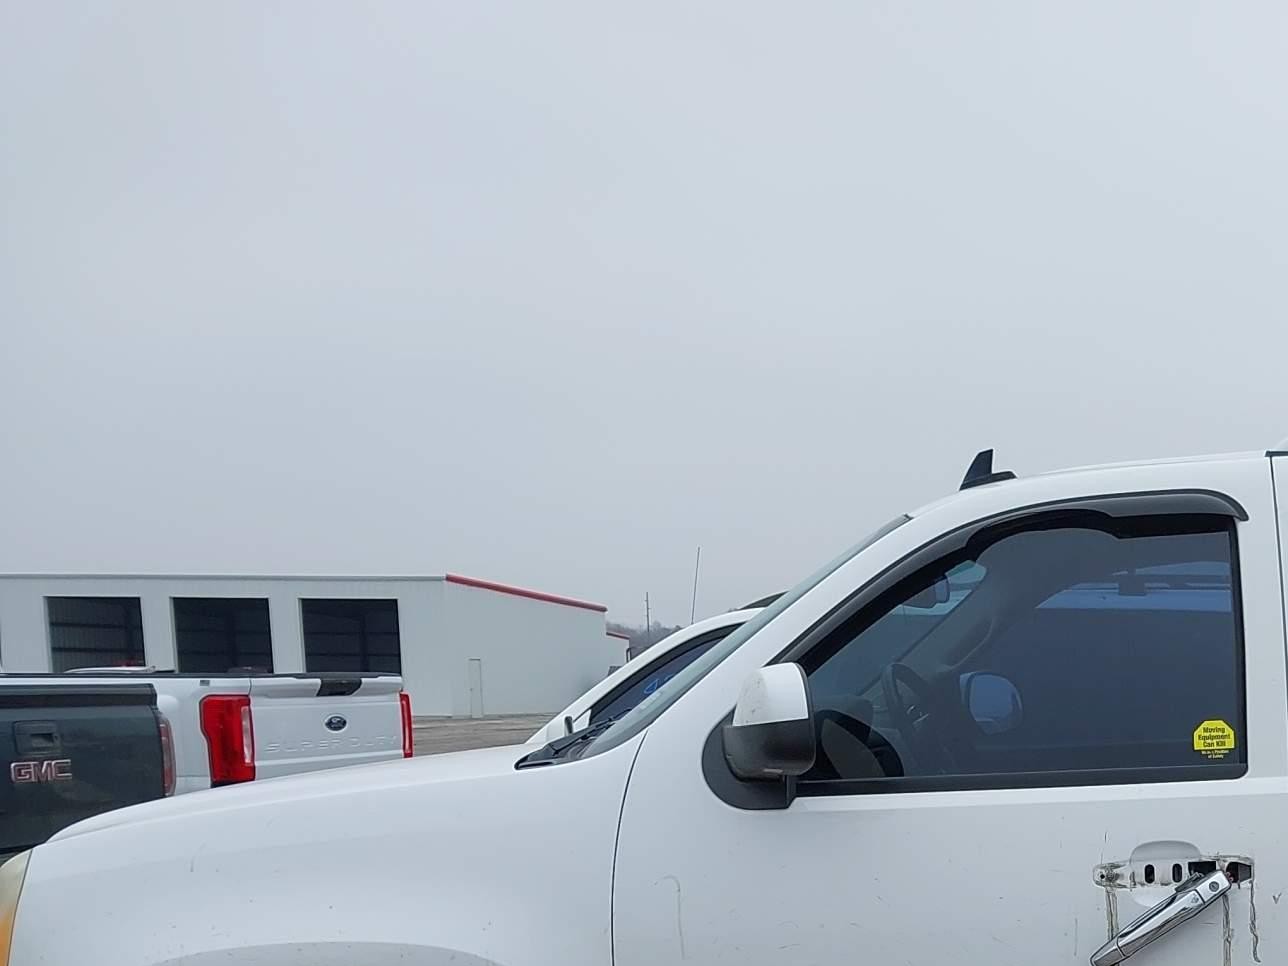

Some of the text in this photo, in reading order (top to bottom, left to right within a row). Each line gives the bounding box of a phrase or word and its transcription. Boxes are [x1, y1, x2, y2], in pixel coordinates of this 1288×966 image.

[1197, 733, 1231, 741] Equipment
[264, 738, 344, 752] SUPER
[10, 759, 72, 783] GMC
